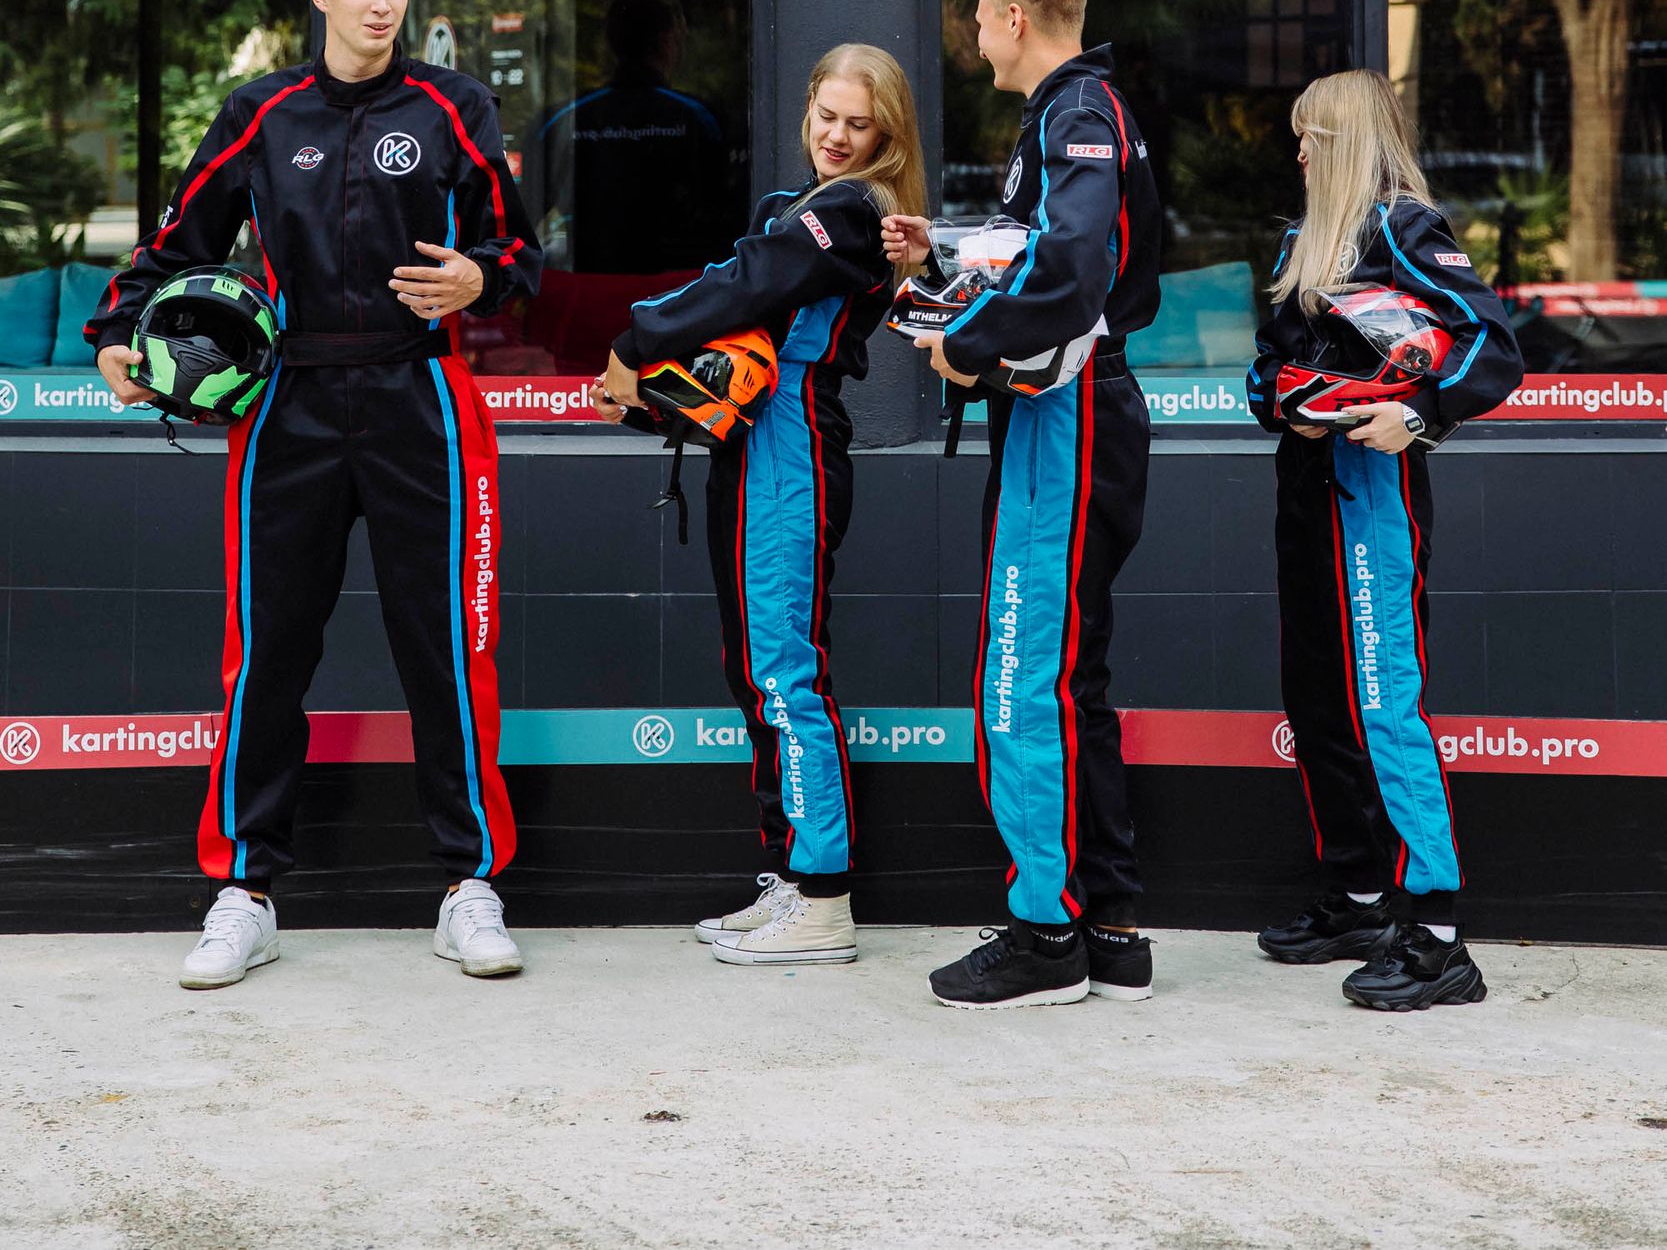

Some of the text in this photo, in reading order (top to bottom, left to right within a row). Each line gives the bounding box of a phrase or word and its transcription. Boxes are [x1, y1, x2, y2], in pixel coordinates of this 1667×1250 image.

[1072, 146, 1108, 156] RLG
[803, 215, 829, 245] RLG
[1440, 254, 1467, 265] RLG
[480, 383, 595, 415] artingcl
[1506, 381, 1667, 413] kartingclub.
[471, 476, 494, 652] kartingclub.pro
[1353, 543, 1381, 711] kartingclub.pro
[992, 565, 1023, 733] kartingclub.pro
